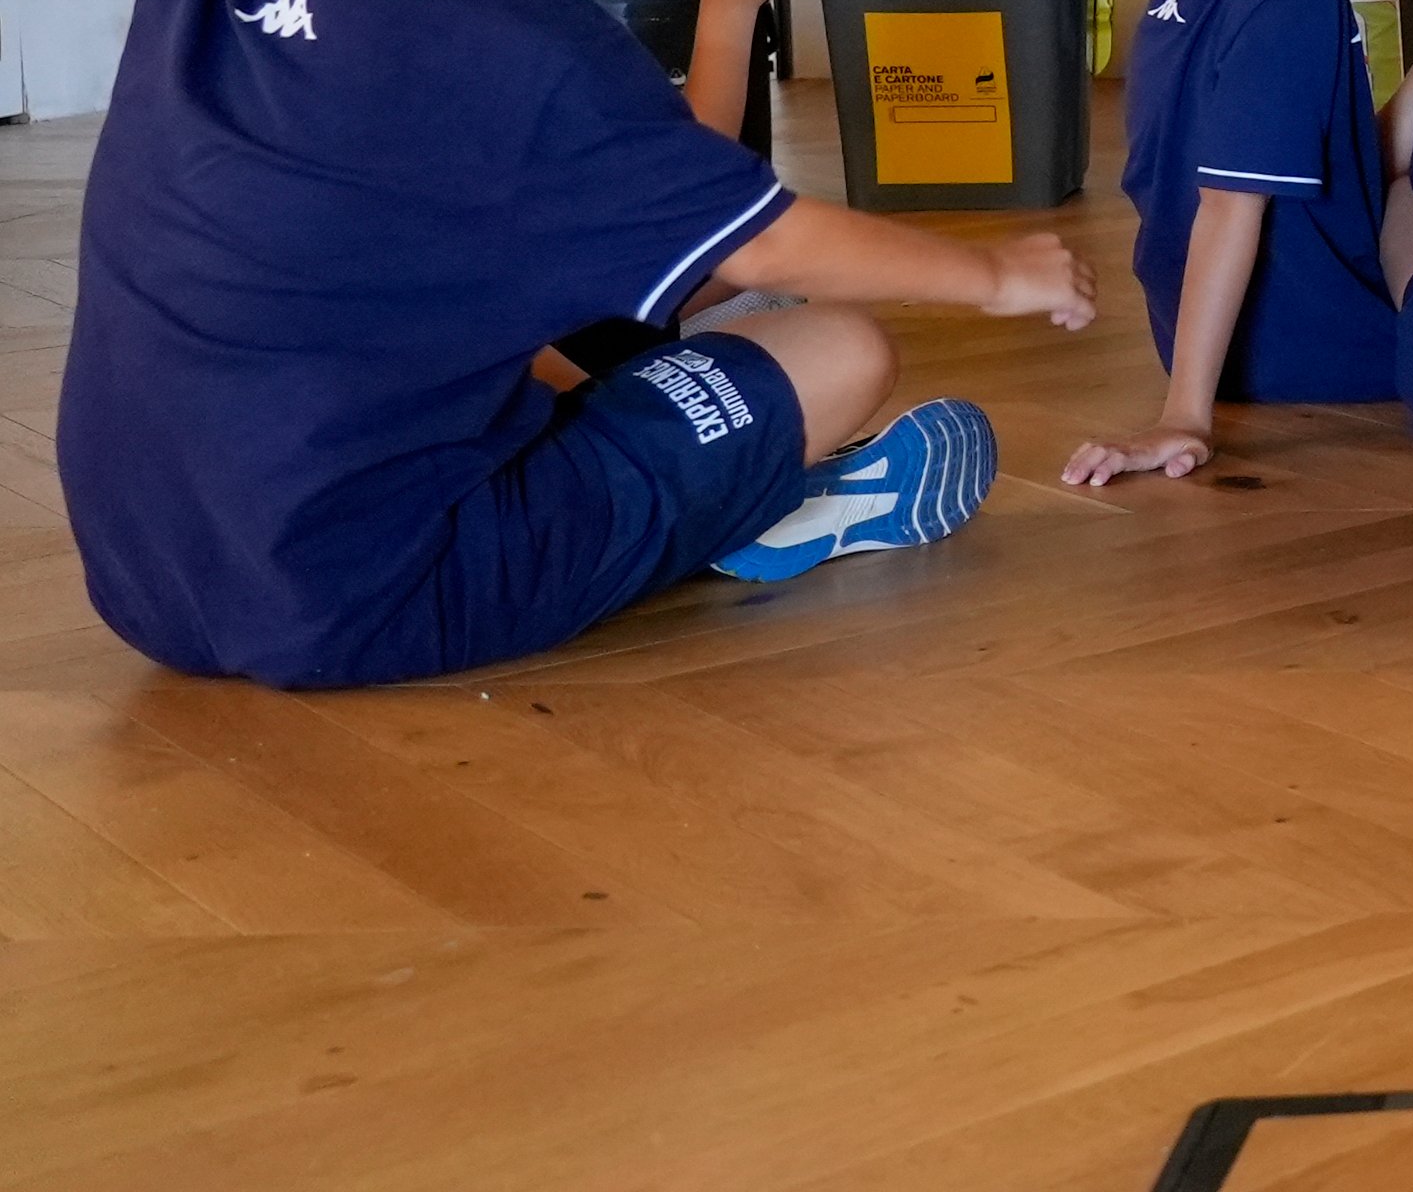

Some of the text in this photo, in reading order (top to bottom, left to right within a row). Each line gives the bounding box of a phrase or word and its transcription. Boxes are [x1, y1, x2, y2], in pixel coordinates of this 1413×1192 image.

[873, 65, 913, 75] CARTA
[874, 75, 944, 84] E CARTONE
[875, 84, 943, 93] PAPER AND
[876, 93, 960, 103] PAPERBOARD
[632, 358, 729, 445] EXPERIENCE
